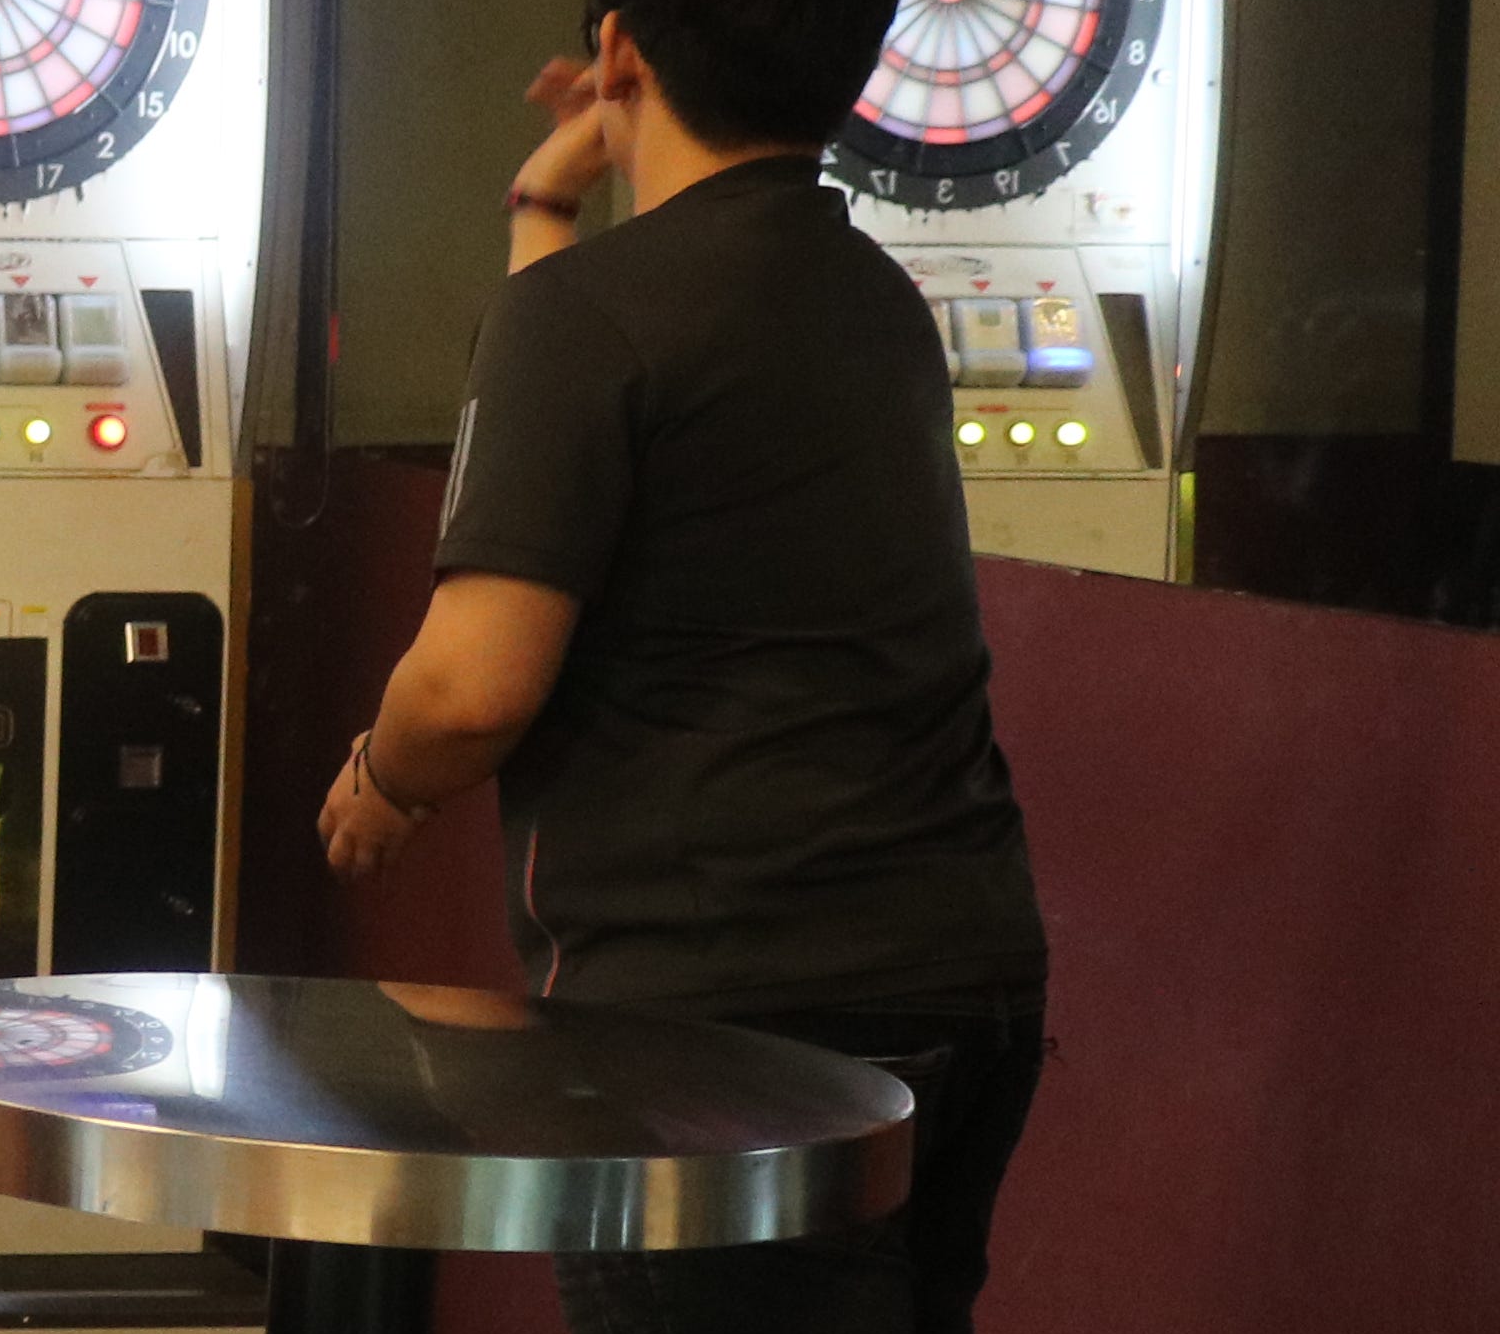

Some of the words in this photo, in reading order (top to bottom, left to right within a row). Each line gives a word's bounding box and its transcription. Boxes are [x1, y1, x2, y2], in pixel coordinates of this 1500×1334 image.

[169, 33, 198, 58] 10
[138, 93, 165, 117] 15
[99, 133, 114, 158] 2
[38, 164, 63, 188] 17
